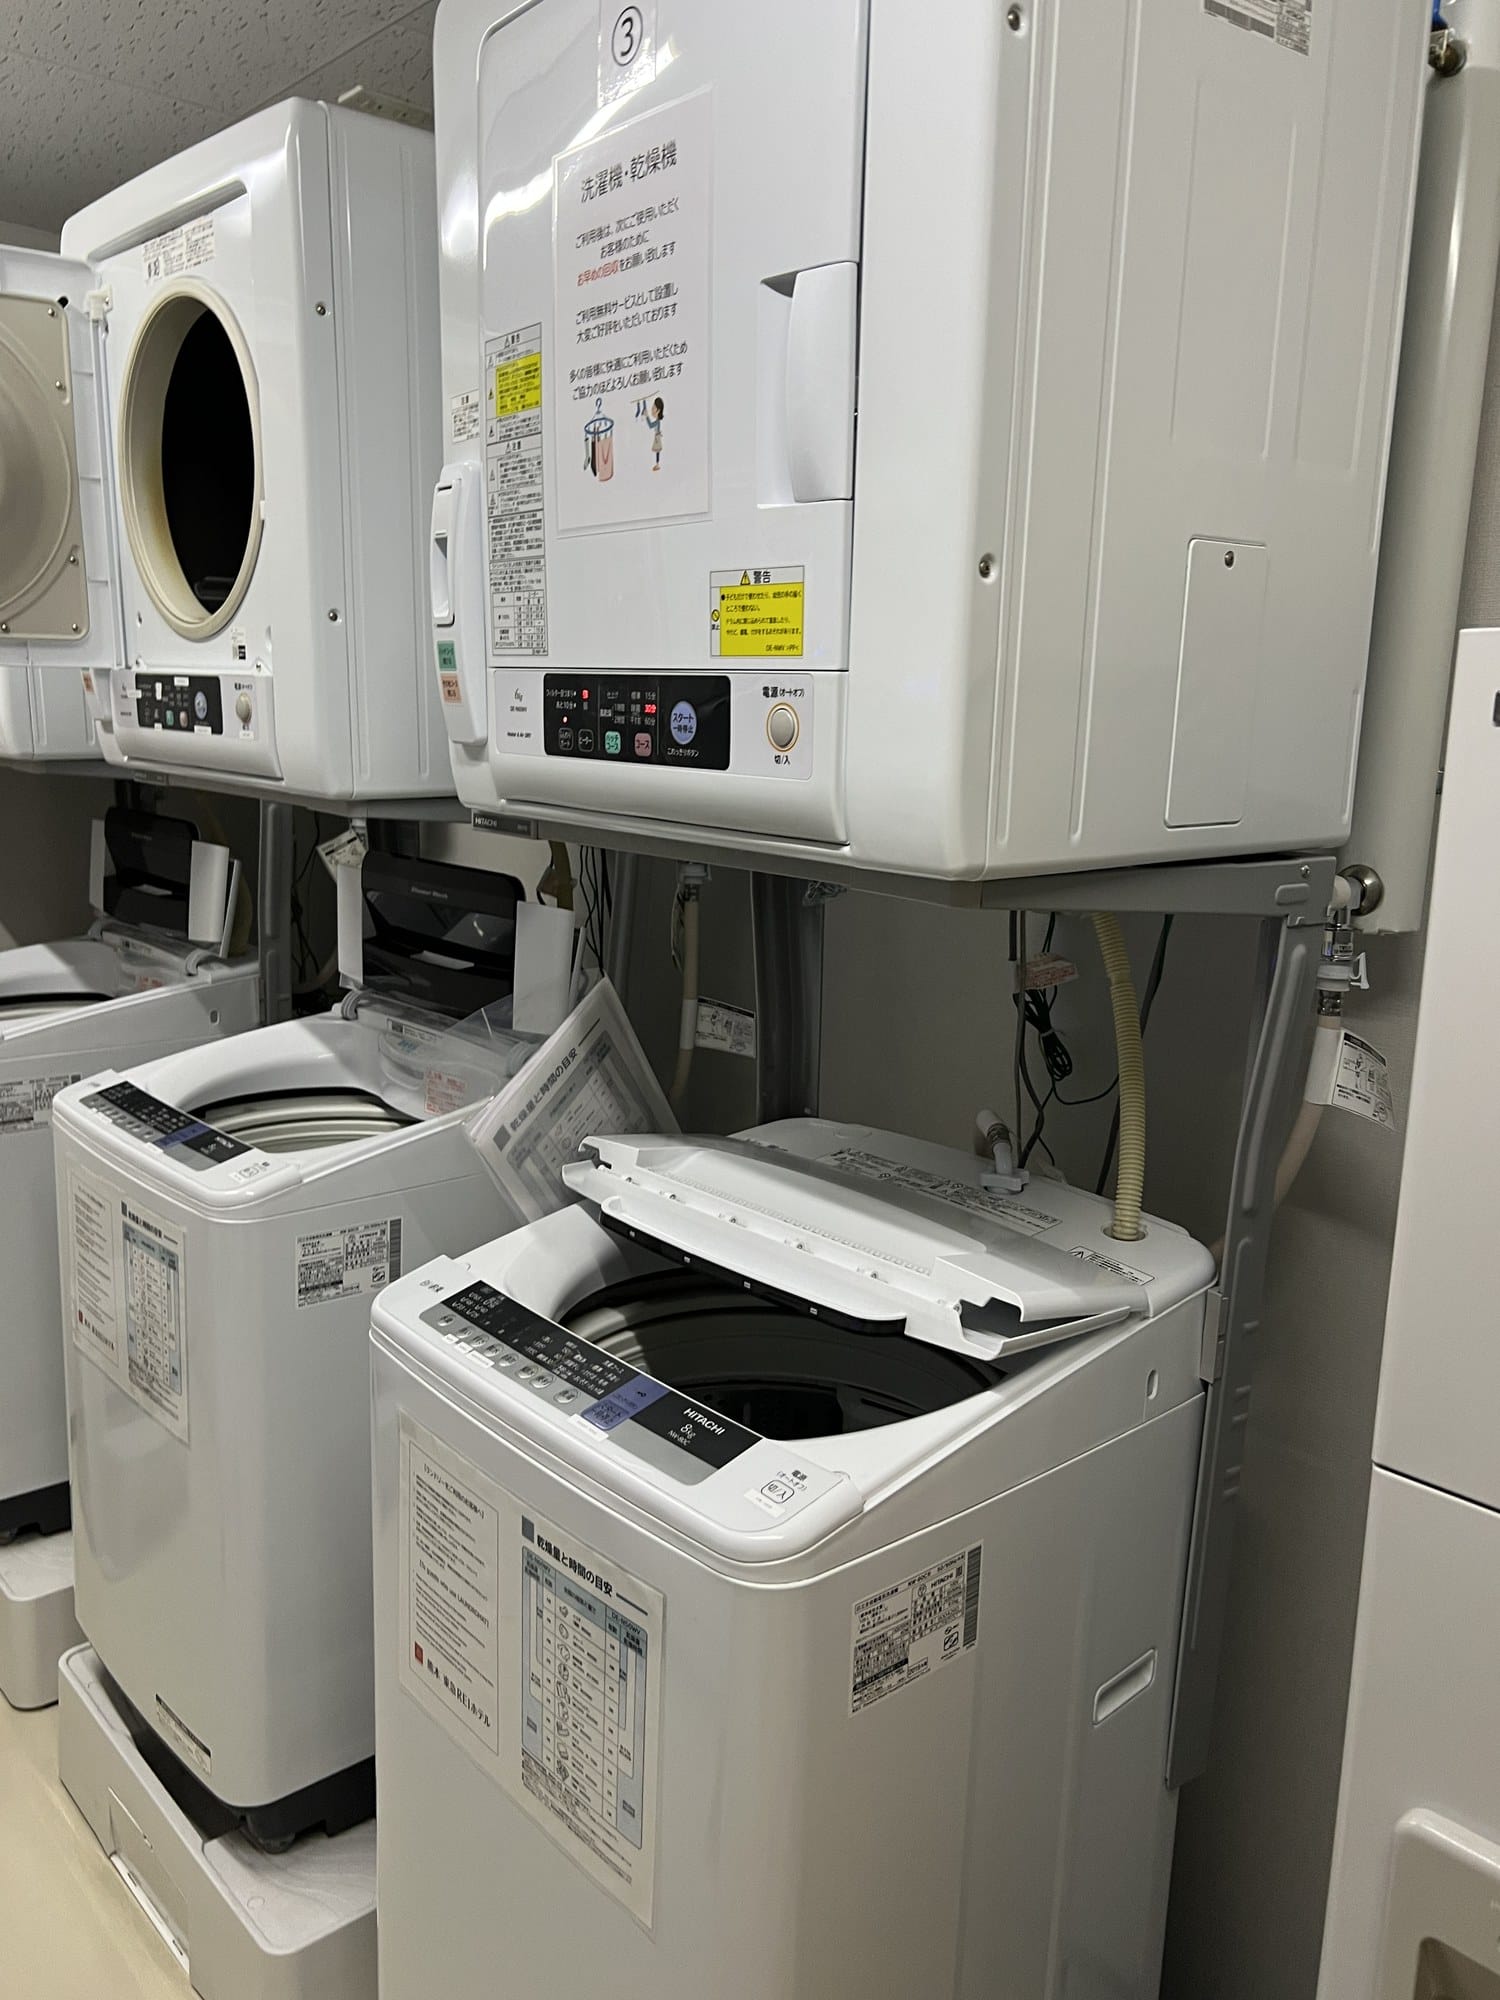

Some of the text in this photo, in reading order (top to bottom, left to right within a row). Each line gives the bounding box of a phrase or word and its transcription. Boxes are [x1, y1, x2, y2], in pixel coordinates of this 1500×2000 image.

[581, 140, 677, 203] 洗濯機・乾燥機
[673, 713, 694, 723] スタート
[682, 1407, 726, 1436] HITACHI
[537, 1534, 613, 1598] 乾燥量と時間の目安
